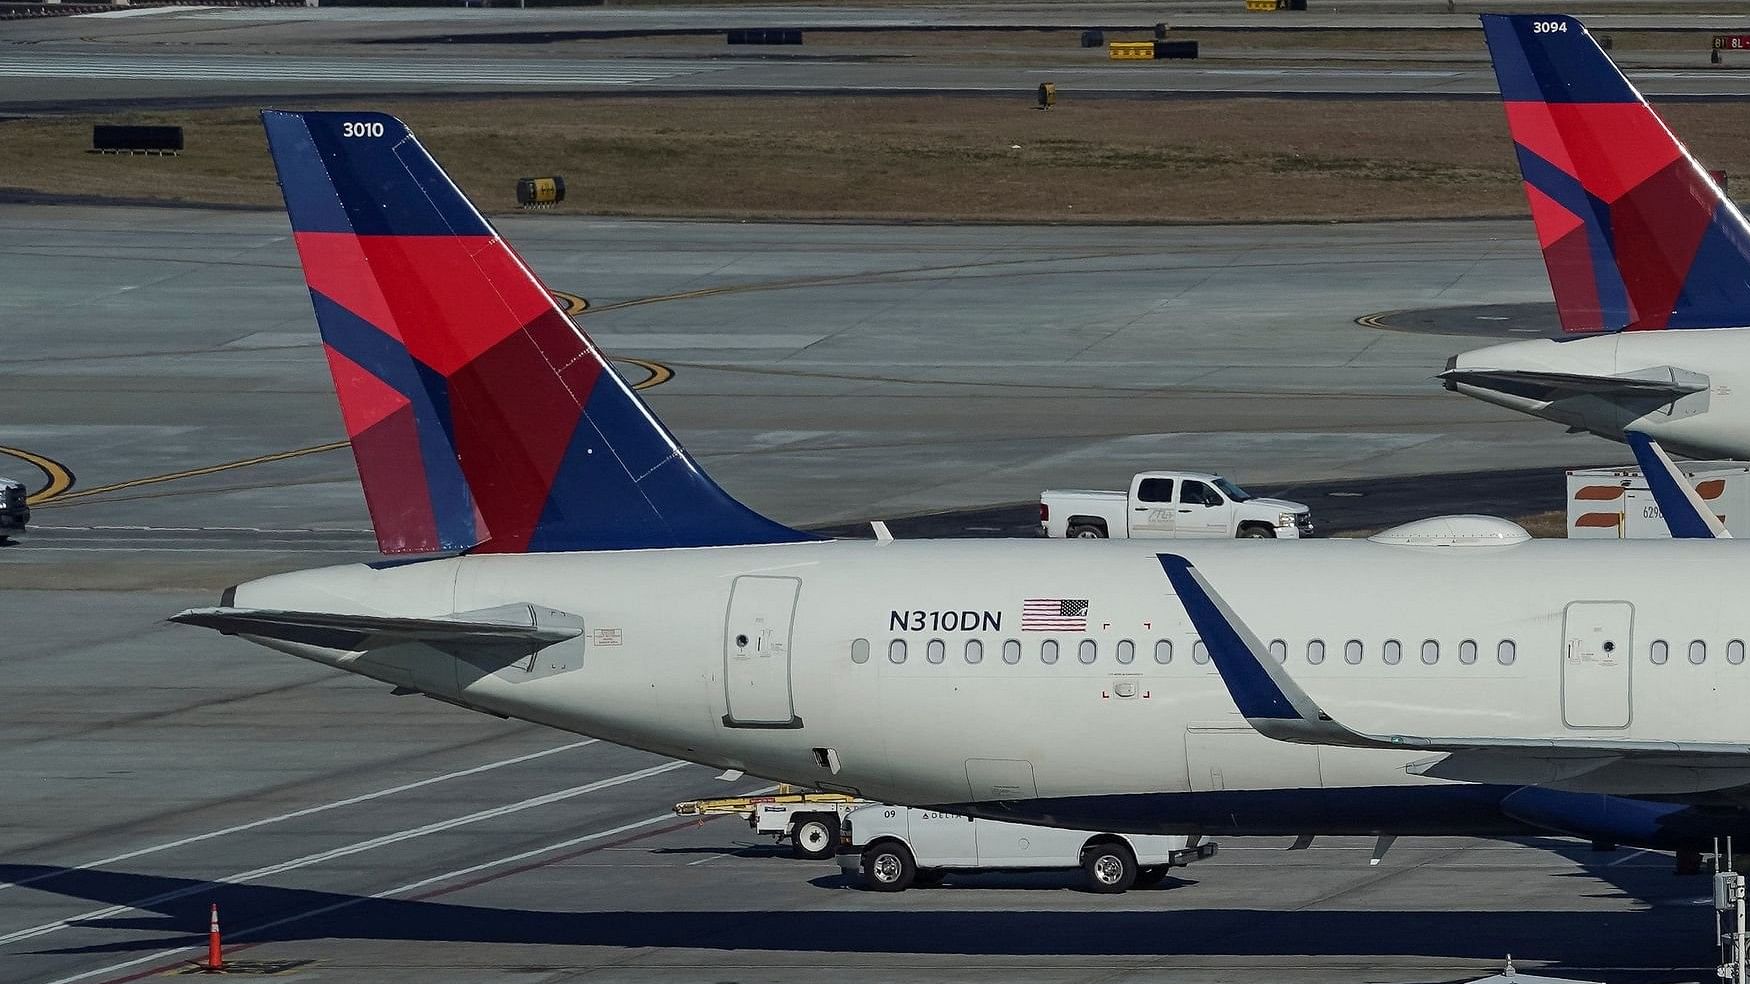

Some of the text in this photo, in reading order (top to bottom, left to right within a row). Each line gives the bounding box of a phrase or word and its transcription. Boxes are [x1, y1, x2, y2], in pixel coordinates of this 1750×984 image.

[1533, 21, 1567, 33] 3094
[1731, 38, 1743, 48] 8L
[343, 122, 384, 137] 3010
[889, 610, 1002, 632] N310DN
[883, 809, 896, 819] 09
